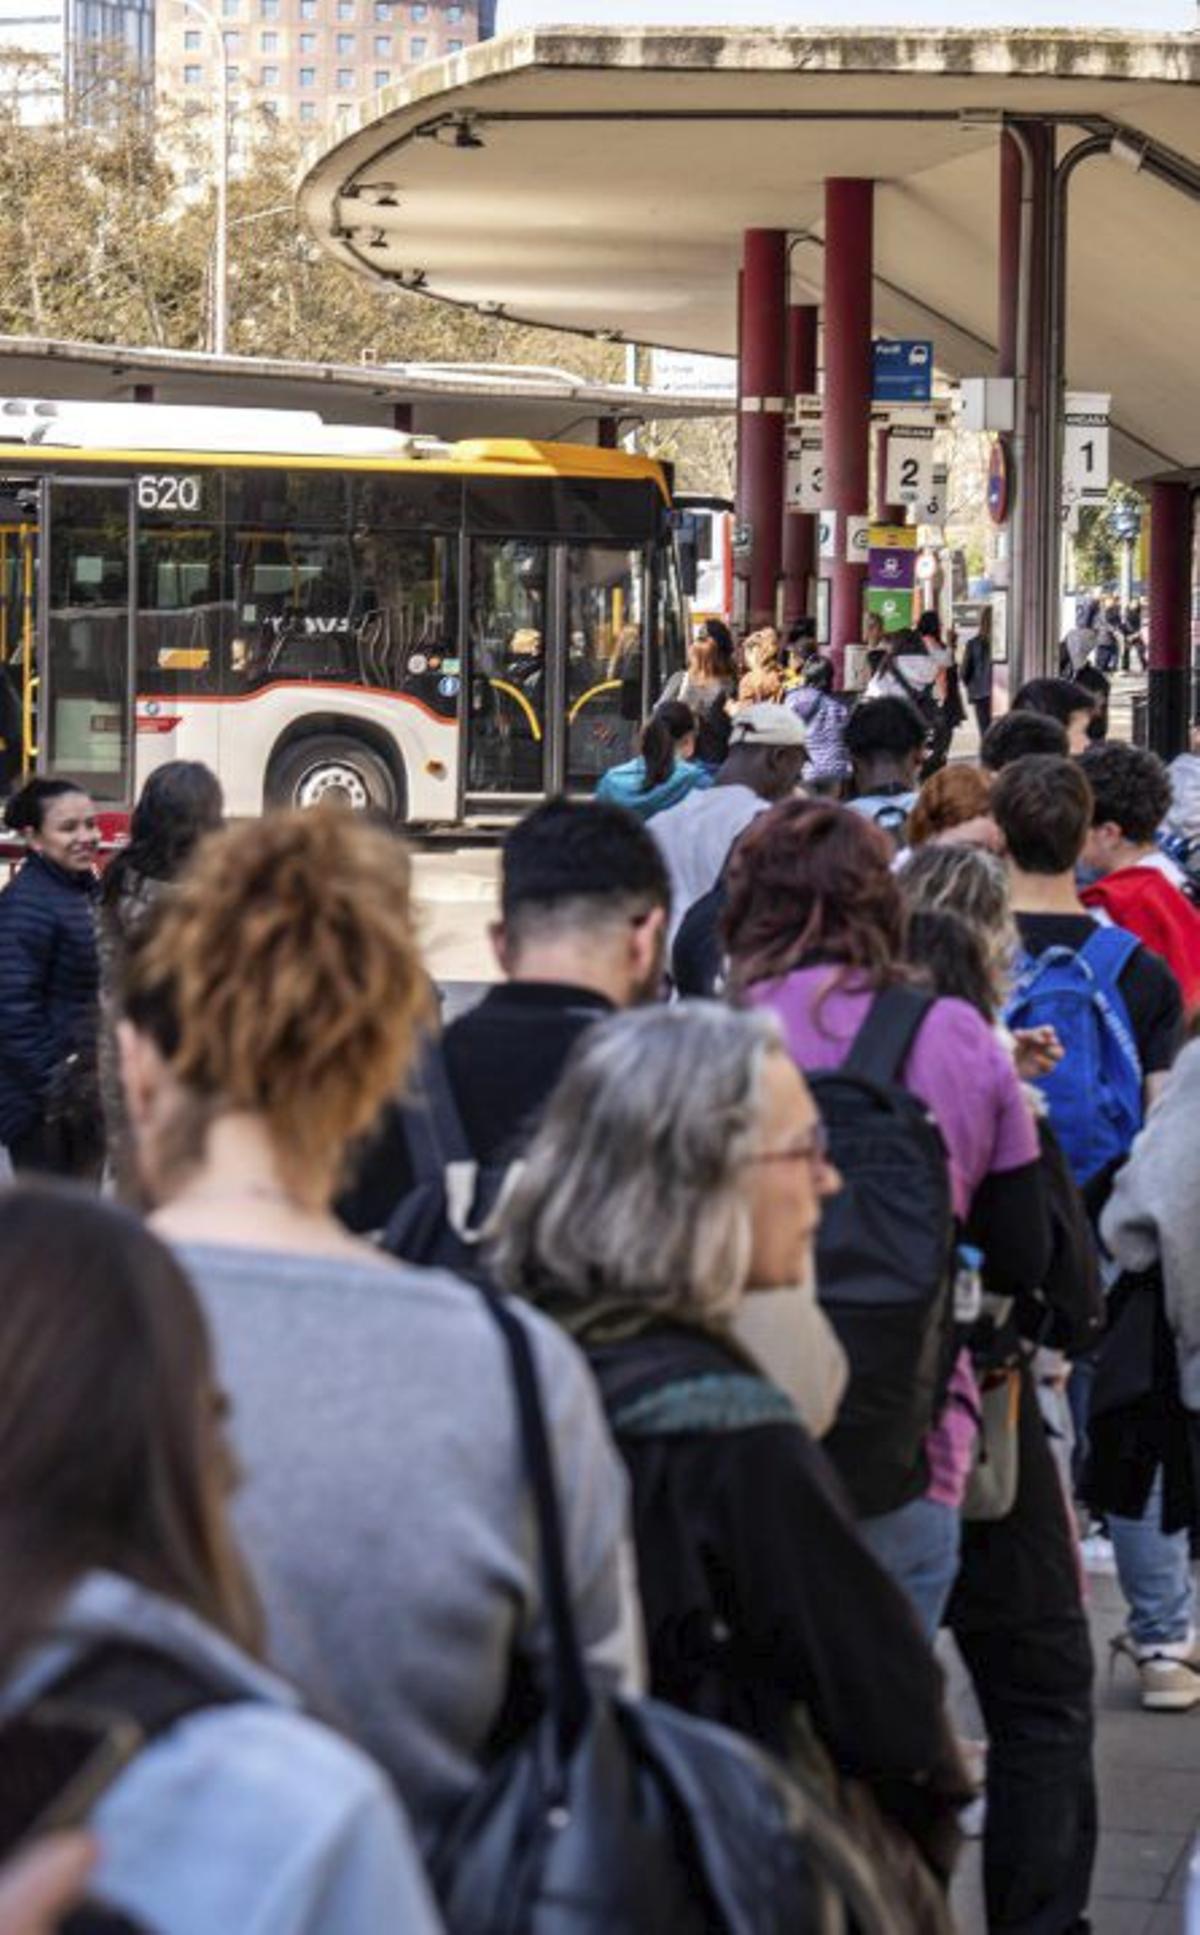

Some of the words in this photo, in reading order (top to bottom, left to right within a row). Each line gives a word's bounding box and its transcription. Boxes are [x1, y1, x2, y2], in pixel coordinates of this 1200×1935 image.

[1080, 441, 1093, 471] 1
[901, 459, 918, 487] 2
[138, 475, 199, 510] 620
